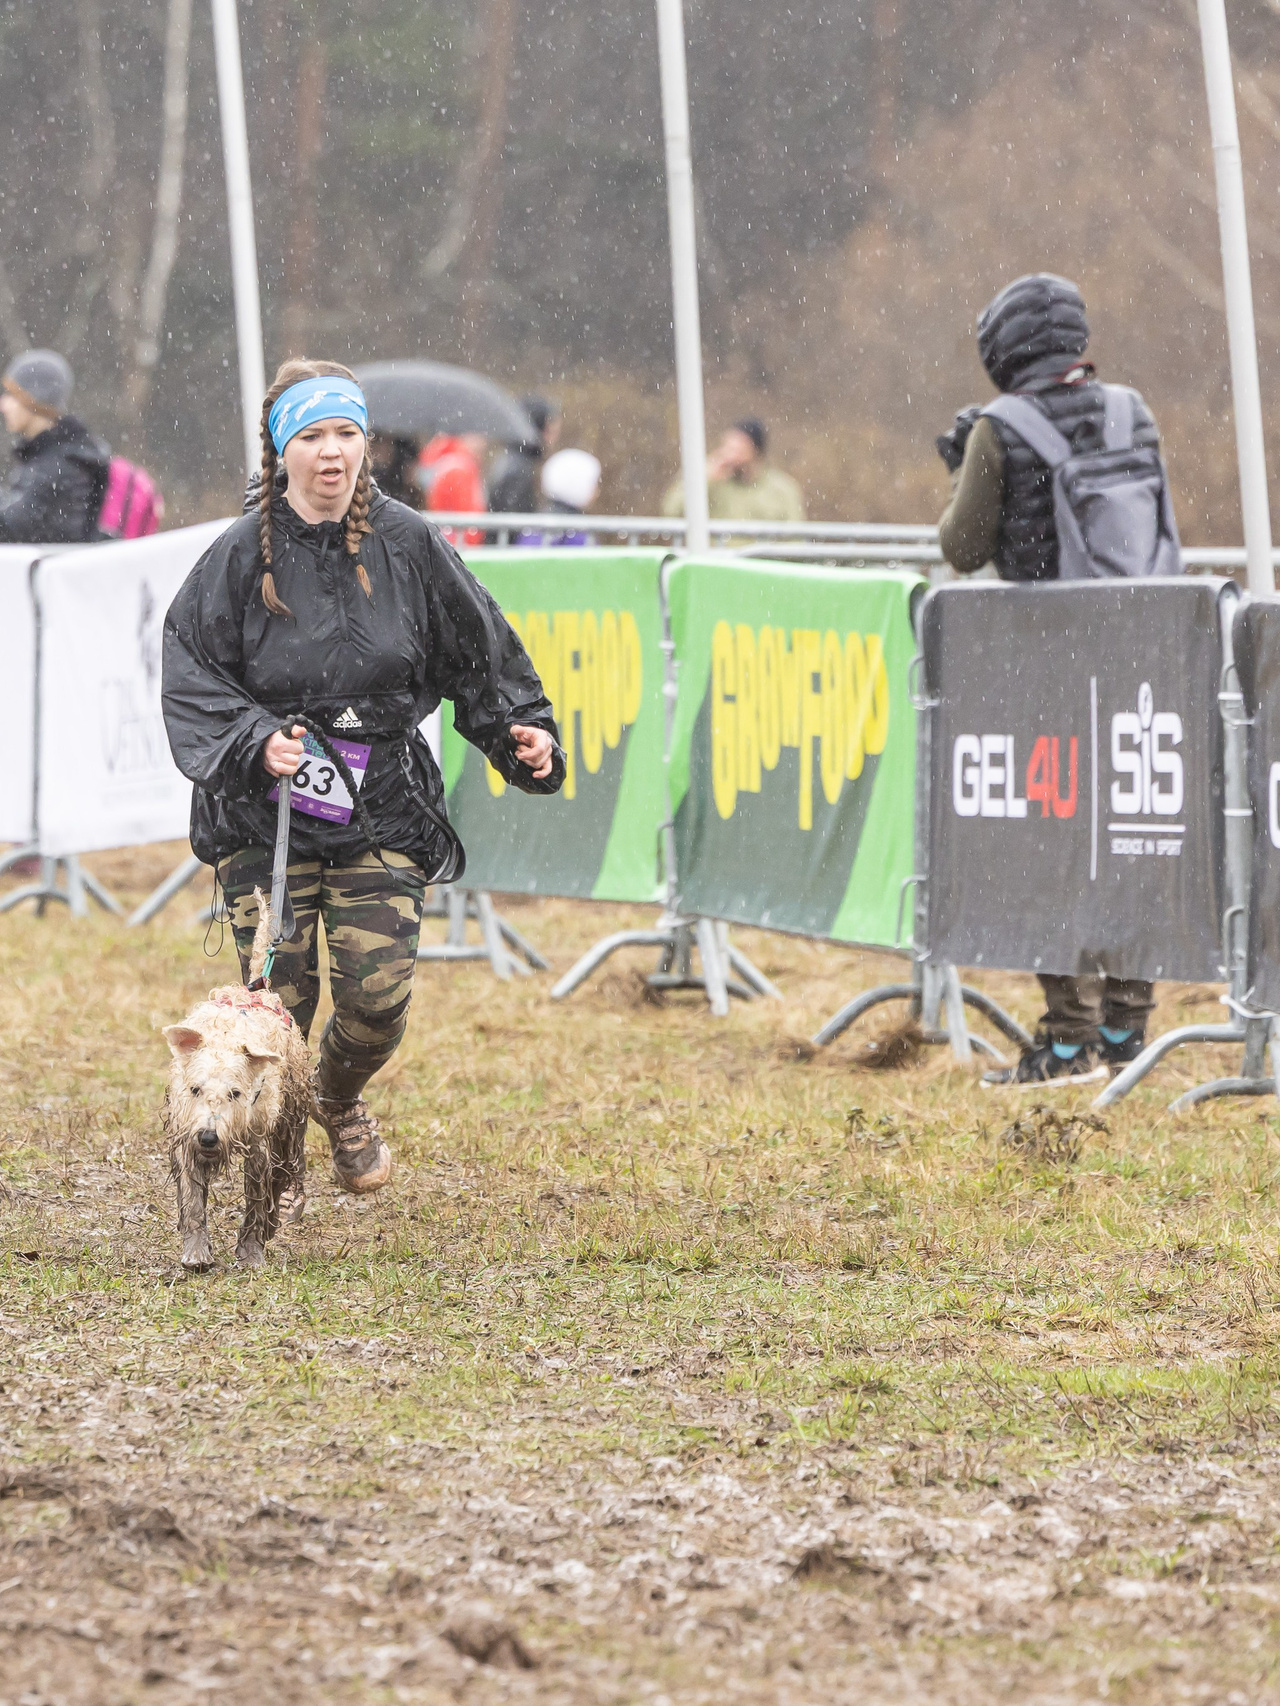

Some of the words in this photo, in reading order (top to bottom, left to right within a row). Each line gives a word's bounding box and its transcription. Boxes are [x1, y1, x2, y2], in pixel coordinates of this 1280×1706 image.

[332, 720, 363, 729] adidas
[292, 759, 336, 796] 63
[952, 734, 1078, 818] GEL4U
